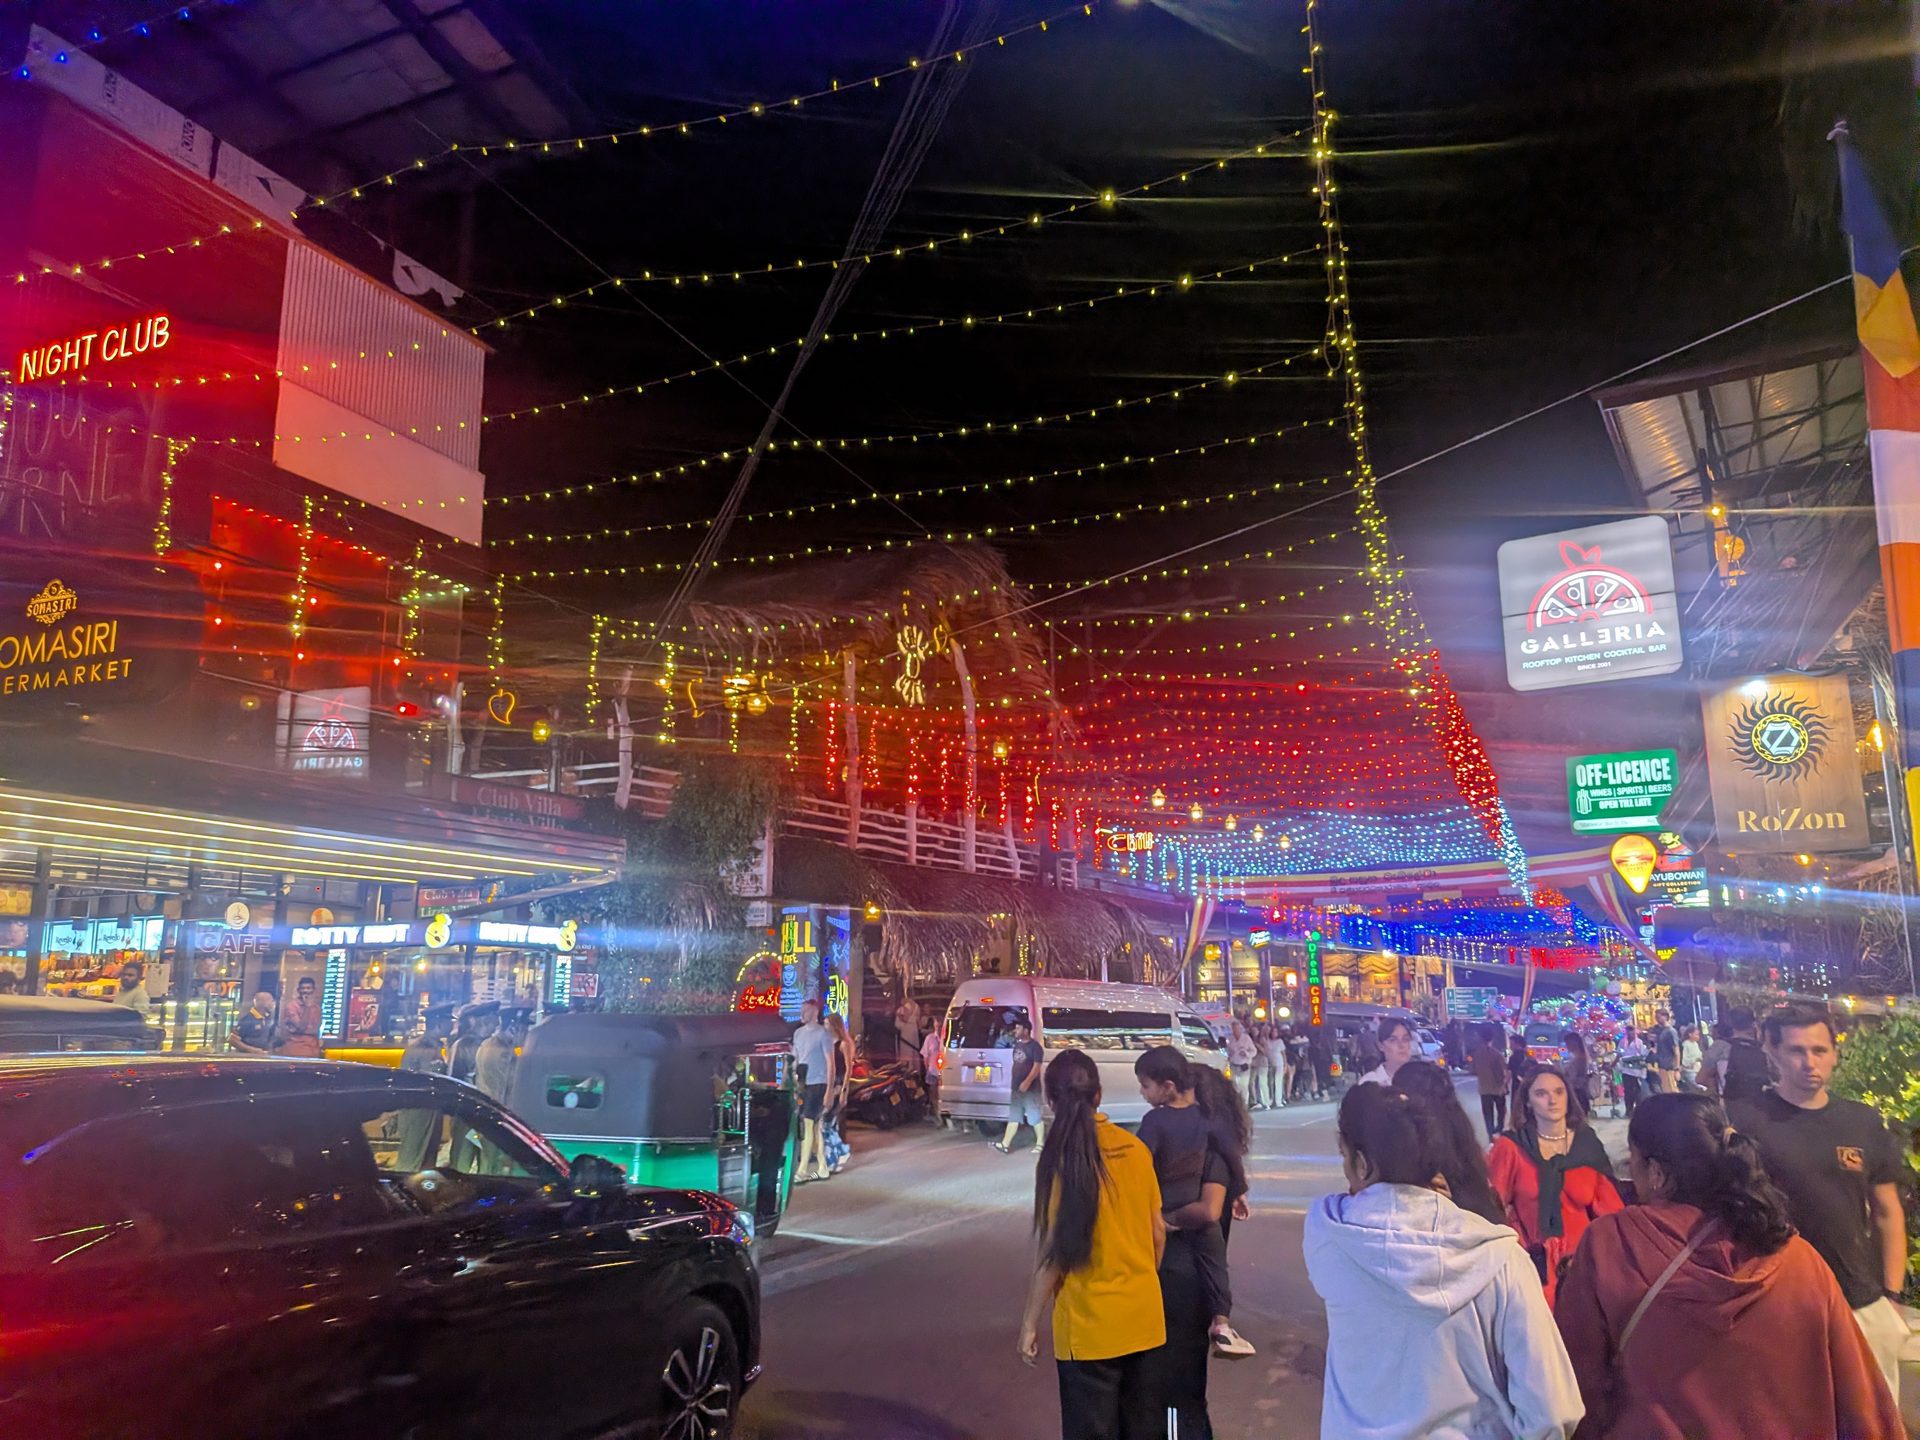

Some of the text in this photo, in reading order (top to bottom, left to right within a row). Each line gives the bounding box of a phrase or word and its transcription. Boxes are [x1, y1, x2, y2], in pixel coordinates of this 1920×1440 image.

[20, 316, 170, 383] NIGHT CLUB
[26, 597, 78, 617] SOMASIRI
[1522, 643, 1667, 669] ROOFTOP KITCHEN COCKTAIL BAR
[3, 658, 132, 694] ERMARKET
[1575, 757, 1672, 787] OFF-LICENCE
[477, 786, 518, 810] Club
[525, 793, 562, 816] Villa
[1590, 784, 1672, 798] WINES SPIRITS BEERS
[1599, 797, 1652, 809] OPEN TILL LATE
[1737, 807, 1847, 832] RoZon
[1650, 871, 1704, 881] AYUBOWAN
[200, 933, 271, 954] CAFE
[1308, 943, 1321, 984] Dream
